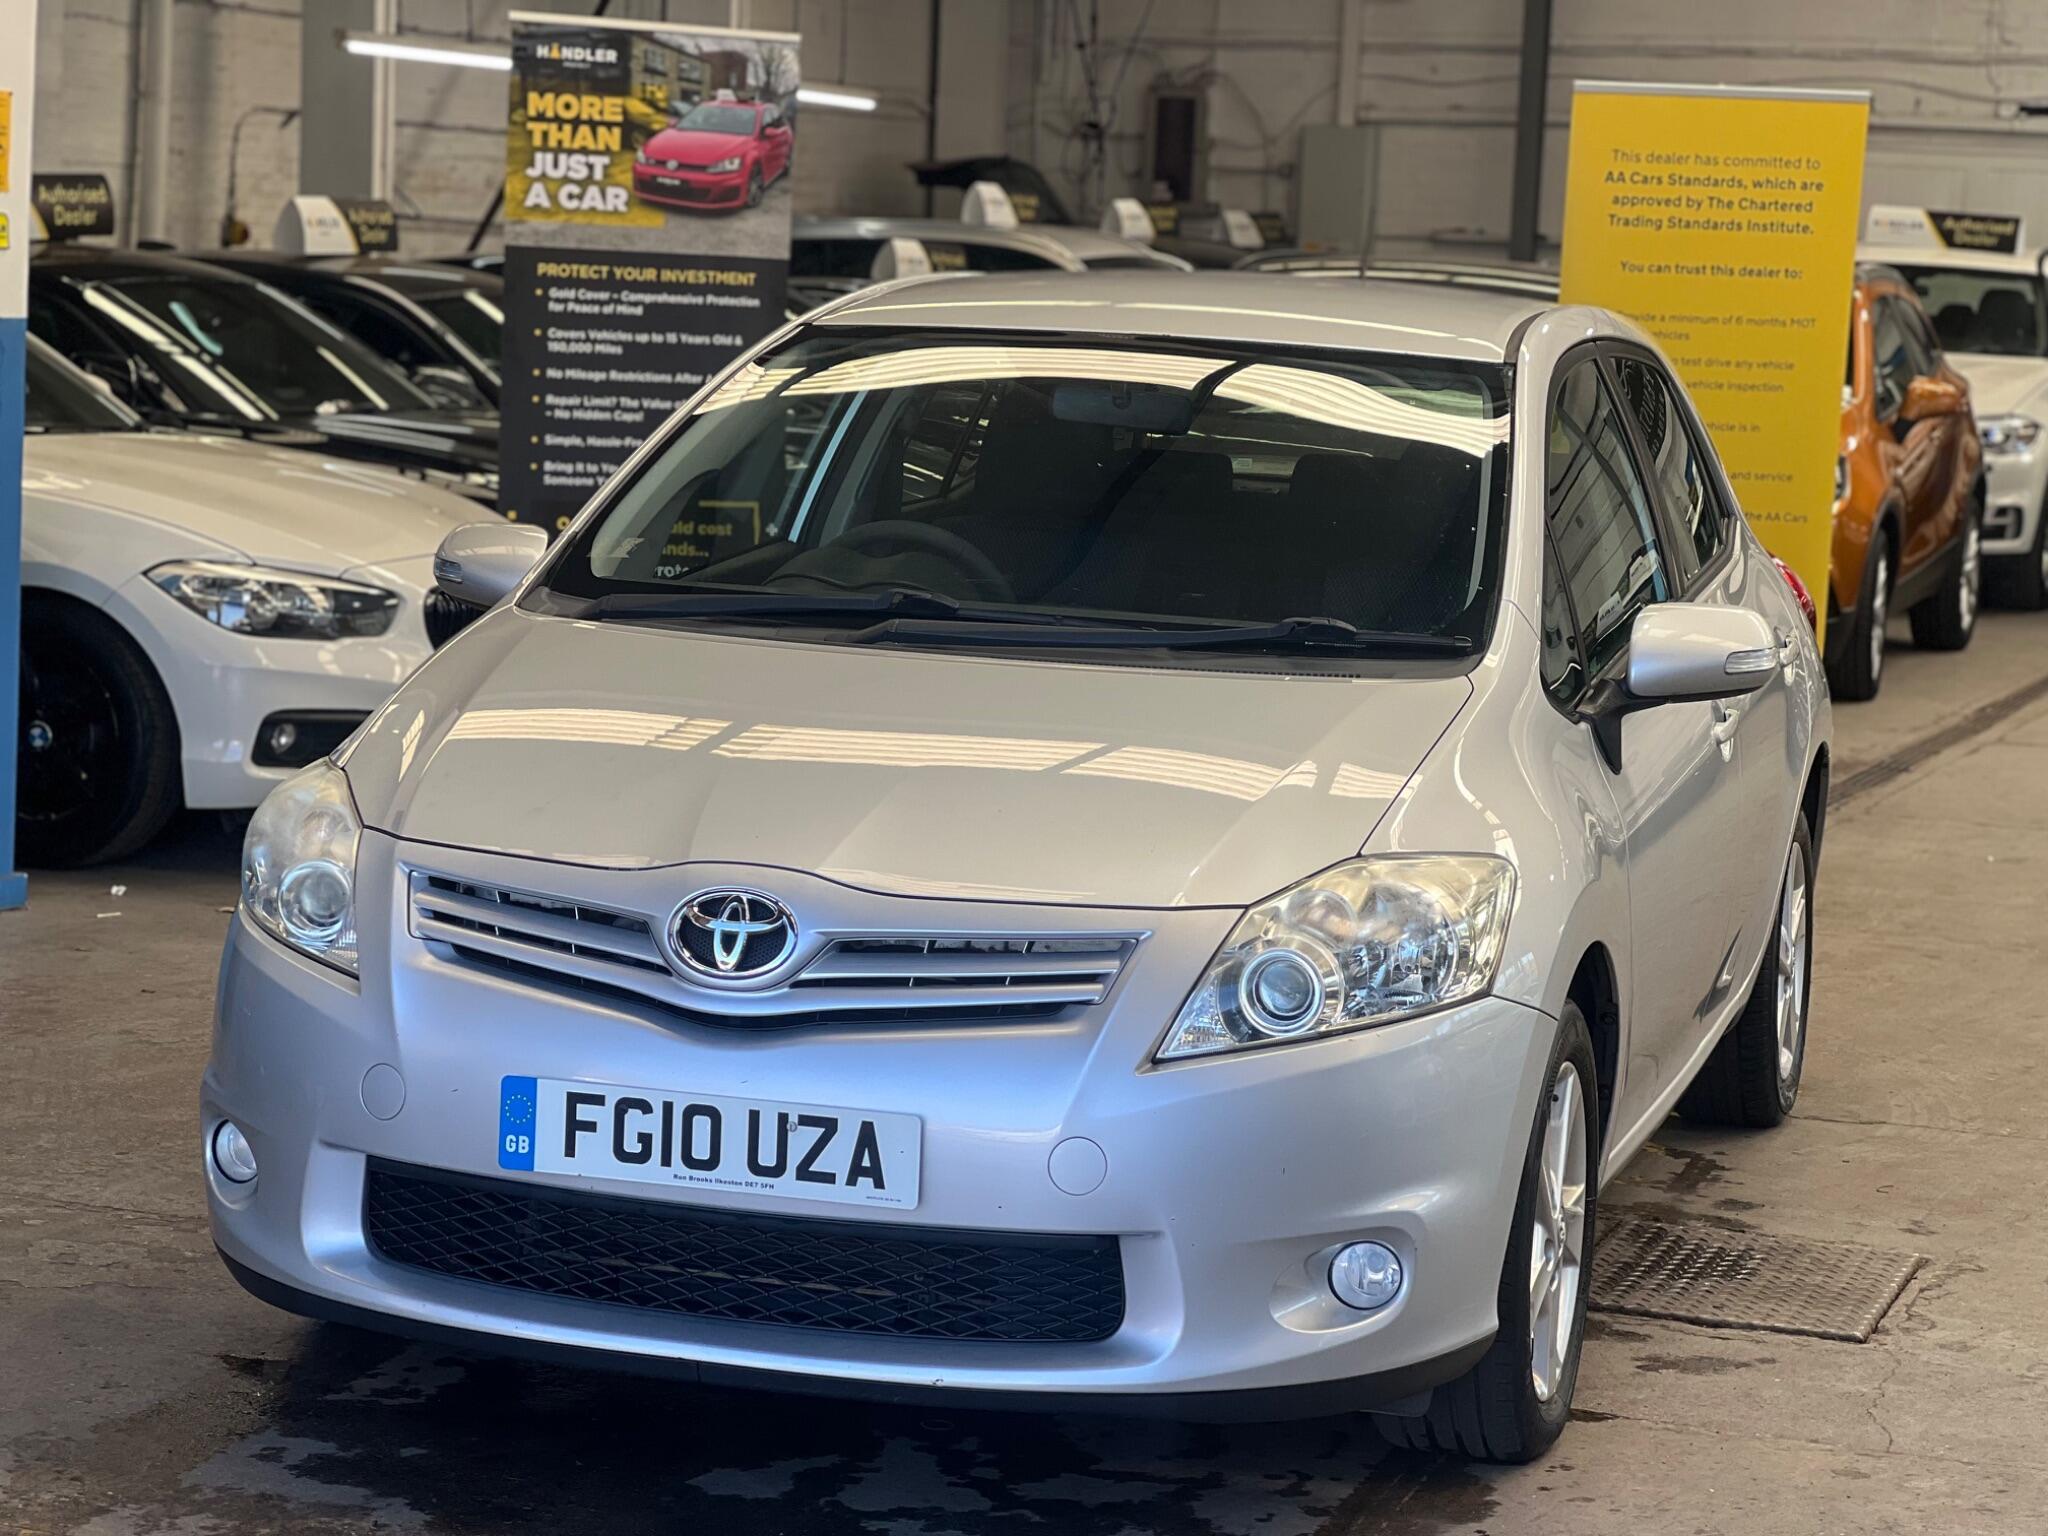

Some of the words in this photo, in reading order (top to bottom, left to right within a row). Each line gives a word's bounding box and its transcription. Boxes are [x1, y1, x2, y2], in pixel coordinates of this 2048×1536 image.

[527, 91, 625, 121] MORE
[526, 121, 622, 151] THAN
[525, 151, 611, 181] JUST
[1612, 148, 1642, 163] This
[1645, 151, 1690, 166] dealer
[1694, 154, 1720, 167] has
[1723, 156, 1802, 169] committed
[1806, 158, 1821, 170] to
[1604, 170, 1626, 184] AA
[1630, 171, 1664, 186] Cars
[1667, 173, 1748, 190] Standards,
[1752, 177, 1796, 191] which
[1800, 180, 1824, 192] are
[524, 182, 551, 208] A
[557, 184, 629, 213] CAR
[1612, 194, 1682, 208] approved
[1686, 195, 1703, 211] by
[1707, 196, 1735, 210] The
[1738, 197, 1814, 213] Chartered
[1608, 214, 1663, 231] Trading
[1667, 216, 1743, 232] Standards
[1746, 220, 1815, 235] Institute.
[537, 262, 610, 279] PROTECT
[612, 266, 657, 282] YOUR
[660, 268, 757, 286] INVESTMENT
[1620, 260, 1645, 273] You
[1647, 263, 1672, 274] can
[1675, 263, 1707, 275] trust
[1711, 264, 1735, 277] this
[1738, 265, 1781, 278] dealer
[1784, 267, 1803, 279] to:
[548, 287, 576, 300] Gold
[577, 288, 610, 301] Cover
[621, 290, 704, 304] Comprehensive
[706, 293, 760, 308] Protection
[548, 300, 565, 312] for
[566, 301, 600, 314] Peace
[602, 302, 615, 314] of
[616, 303, 644, 315] Mind
[1669, 314, 1719, 324] minimum
[1722, 315, 1733, 325] of
[1745, 317, 1787, 328] months
[1789, 317, 1816, 328] MOT
[547, 327, 586, 340] Covers
[587, 329, 633, 342] Vehicles
[635, 331, 650, 344] up
[651, 331, 664, 343] to
[679, 332, 711, 345] Years
[712, 333, 733, 346] Old
[594, 342, 623, 355] Miles
[1681, 357, 1702, 367] test
[1705, 357, 1732, 368] drive
[1735, 360, 1753, 371] any
[1756, 359, 1795, 371] vehicle
[546, 367, 563, 379] No
[564, 368, 607, 382] Mileage
[608, 369, 672, 383] Restrictions
[674, 371, 703, 384] After
[545, 393, 581, 407] Repair
[619, 396, 640, 409] The
[641, 397, 673, 410] Value
[553, 407, 571, 419] No
[572, 408, 612, 420] Hidden
[586, 435, 643, 448] Hassle-Fre
[543, 460, 574, 474] Bring
[586, 462, 599, 474] to
[601, 463, 620, 474] Yo
[543, 474, 595, 486] Someone
[697, 523, 733, 535] cost
[505, 1134, 530, 1154] GB
[564, 1091, 722, 1171] FG10
[747, 1109, 886, 1190] UZA
[688, 1174, 713, 1184] Brooks
[760, 1182, 775, 1190] 5FH
